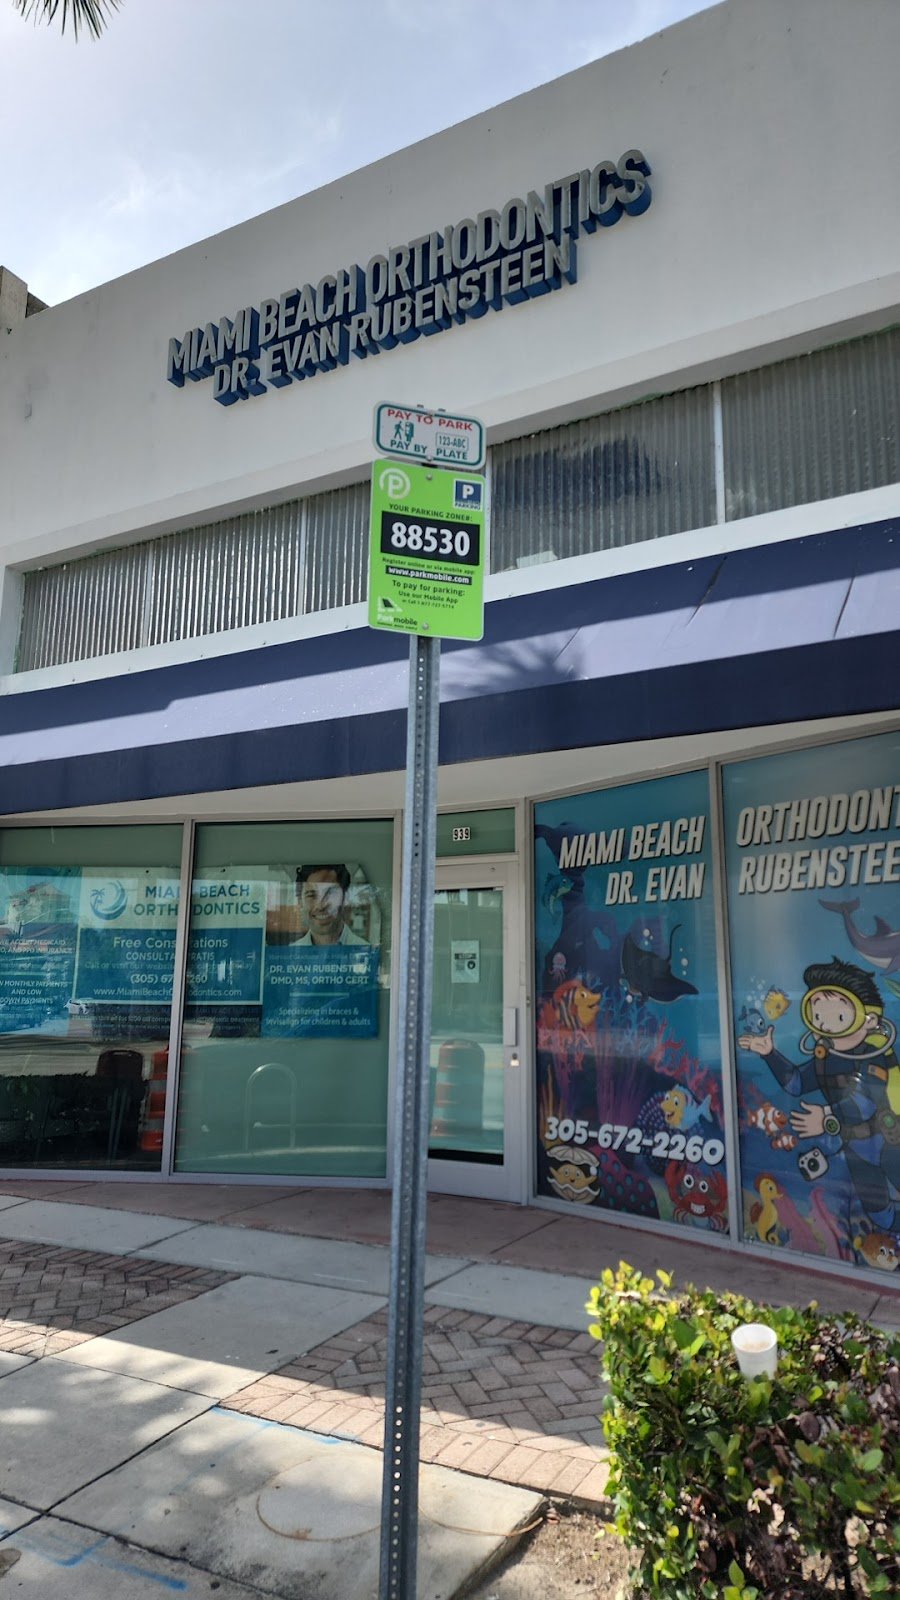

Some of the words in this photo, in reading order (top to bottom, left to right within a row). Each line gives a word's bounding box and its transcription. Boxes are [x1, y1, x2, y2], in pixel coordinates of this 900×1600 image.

[167, 307, 257, 383] MIAMI
[258, 264, 365, 352] BEACH
[365, 149, 653, 304] ORTHODONTICS
[214, 356, 264, 404] DR.
[265, 321, 349, 387] EVAN
[348, 239, 577, 358] RUBENSTEEN
[387, 408, 412, 420] PAY
[416, 413, 433, 425] TO
[438, 418, 473, 431] PARK
[438, 435, 466, 448] 123-ABC
[390, 439, 411, 451] PAY
[414, 444, 427, 454] BY
[436, 448, 468, 460] PLATE
[462, 484, 475, 499] P
[389, 502, 409, 512] YOUR
[411, 506, 444, 518] PARKING
[390, 521, 471, 557] 88530
[387, 566, 470, 584] www.parkmobile.com
[392, 579, 401, 587] To
[403, 582, 417, 590] pay
[419, 583, 431, 592] for
[433, 585, 466, 597] parking:
[398, 590, 410, 598] Use
[424, 593, 445, 602] Mobile
[446, 596, 459, 604] App
[453, 828, 470, 840] 939
[559, 827, 625, 869] MIAMI
[628, 815, 706, 862] BEACH
[605, 871, 638, 906] DR.
[645, 862, 706, 902] EVAN
[738, 840, 900, 895] RUBENSTEE
[145, 885, 180, 898] MIA
[200, 884, 250, 898] BEACH
[113, 936, 142, 948] Free
[126, 951, 175, 961] CONSULTA
[191, 951, 215, 961] RATIS
[270, 965, 285, 974] DR.
[287, 964, 311, 973] EVAN
[313, 964, 371, 973] RUBENSTN
[130, 973, 158, 985] (305)
[270, 976, 294, 985] DMD,
[295, 976, 310, 986] MS,
[311, 976, 343, 985] ORTHO
[345, 976, 369, 985] CERT
[329, 1007, 352, 1015] braces
[349, 1018, 371, 1026] adults
[545, 1116, 725, 1167] 305-672-2260
